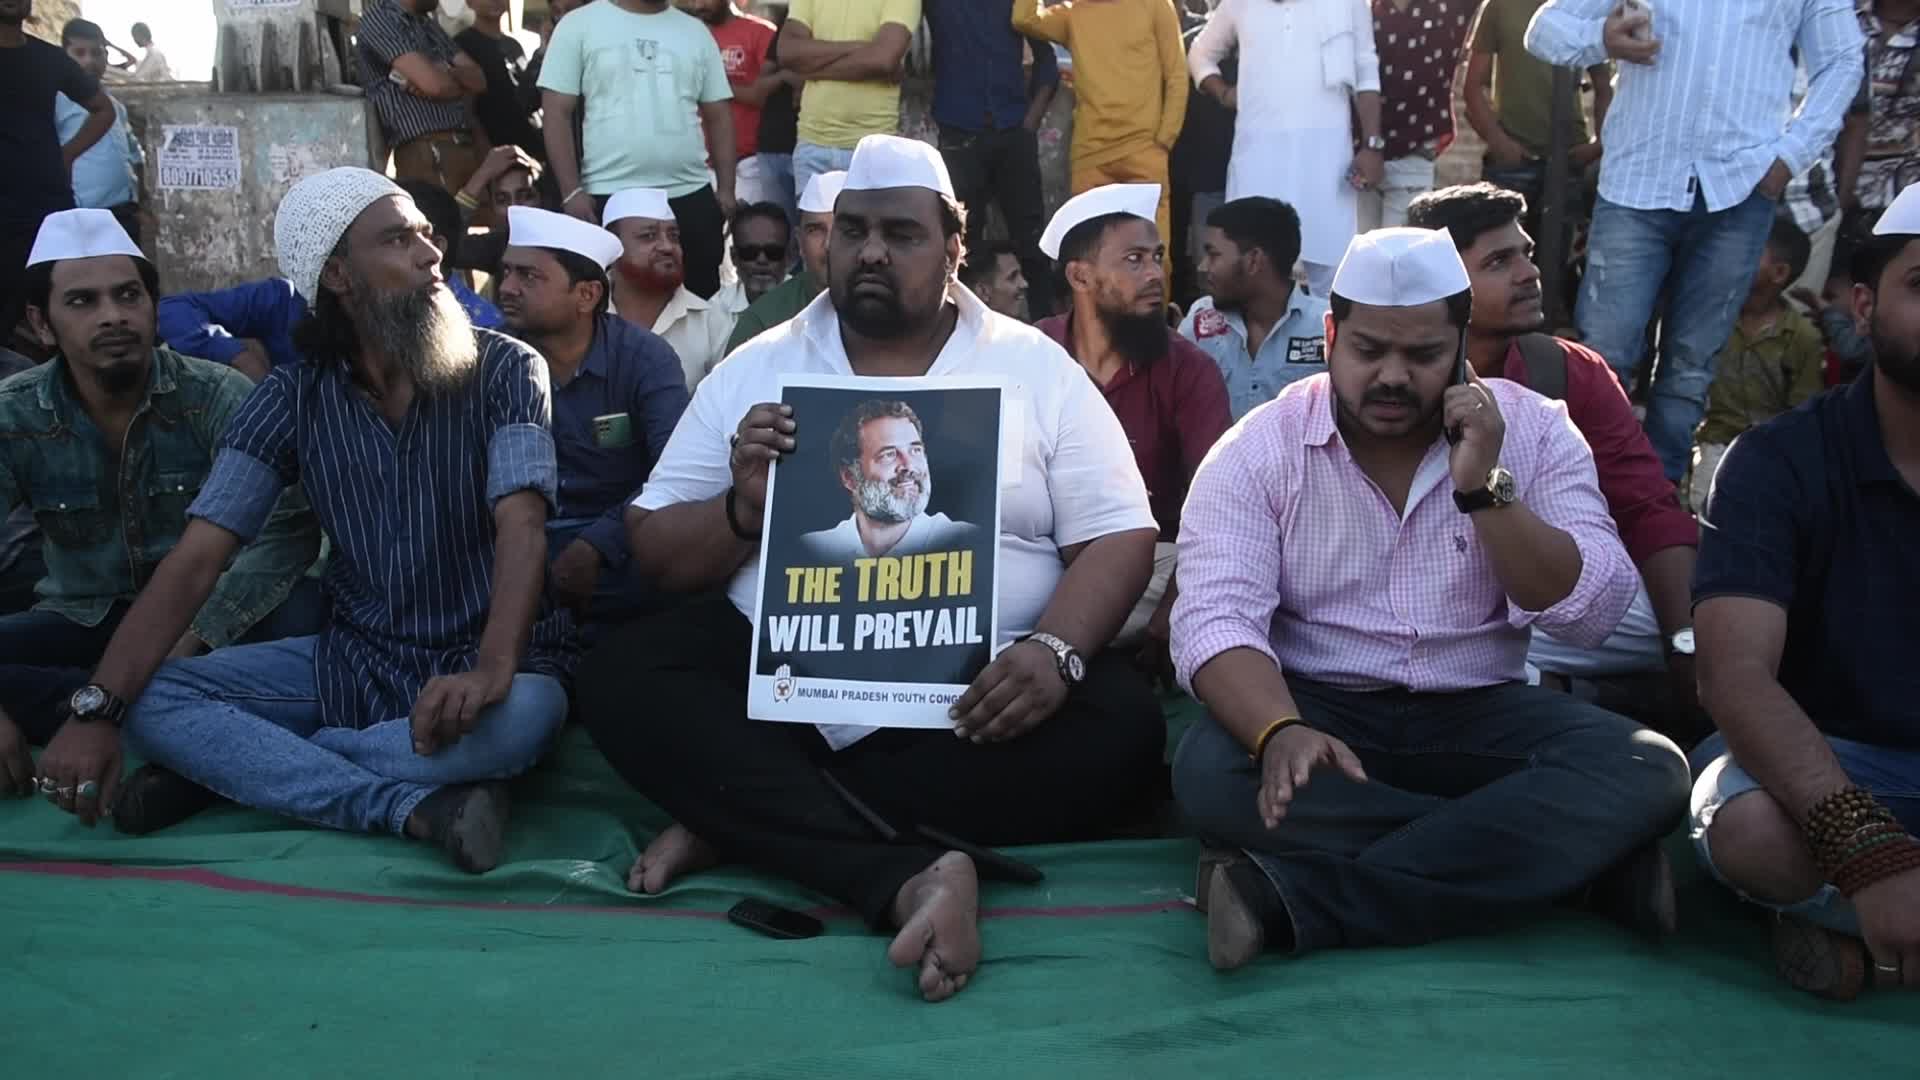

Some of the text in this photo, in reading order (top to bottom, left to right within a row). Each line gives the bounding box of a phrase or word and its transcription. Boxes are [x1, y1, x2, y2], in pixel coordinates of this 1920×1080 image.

[785, 550, 973, 604] THE TRUTH
[768, 606, 983, 653] WILL PREVAIL
[797, 687, 838, 699] MUMBAI
[841, 690, 889, 703] PRADESH
[892, 692, 926, 704] YOUTH
